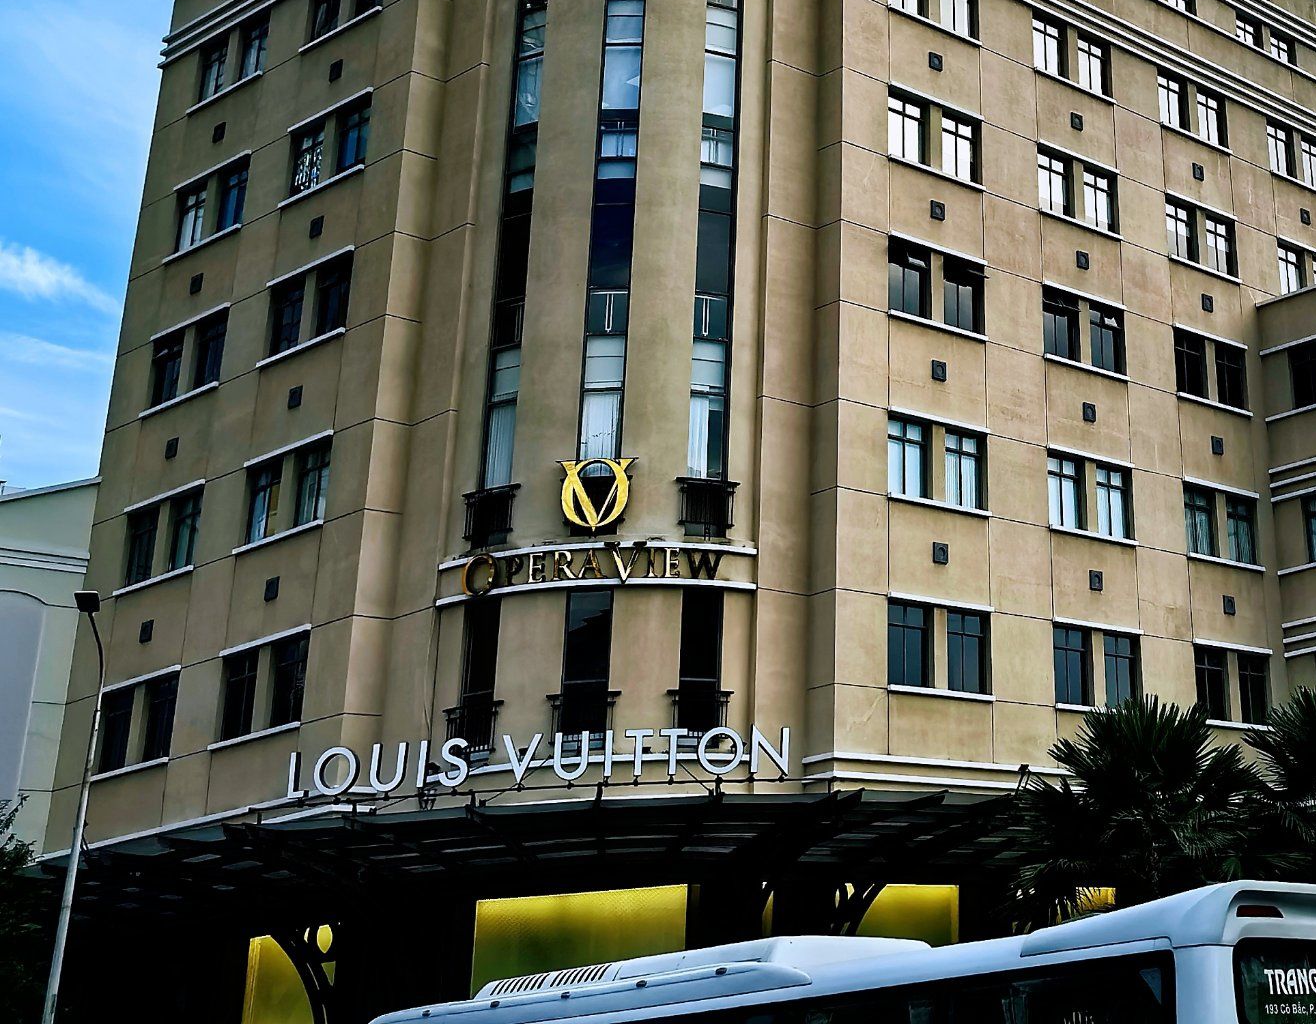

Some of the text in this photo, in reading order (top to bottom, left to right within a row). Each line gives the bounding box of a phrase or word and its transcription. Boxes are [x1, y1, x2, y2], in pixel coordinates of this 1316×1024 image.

[287, 725, 791, 799] LOUIS VUITTON
[1265, 1004, 1279, 1015] 193
